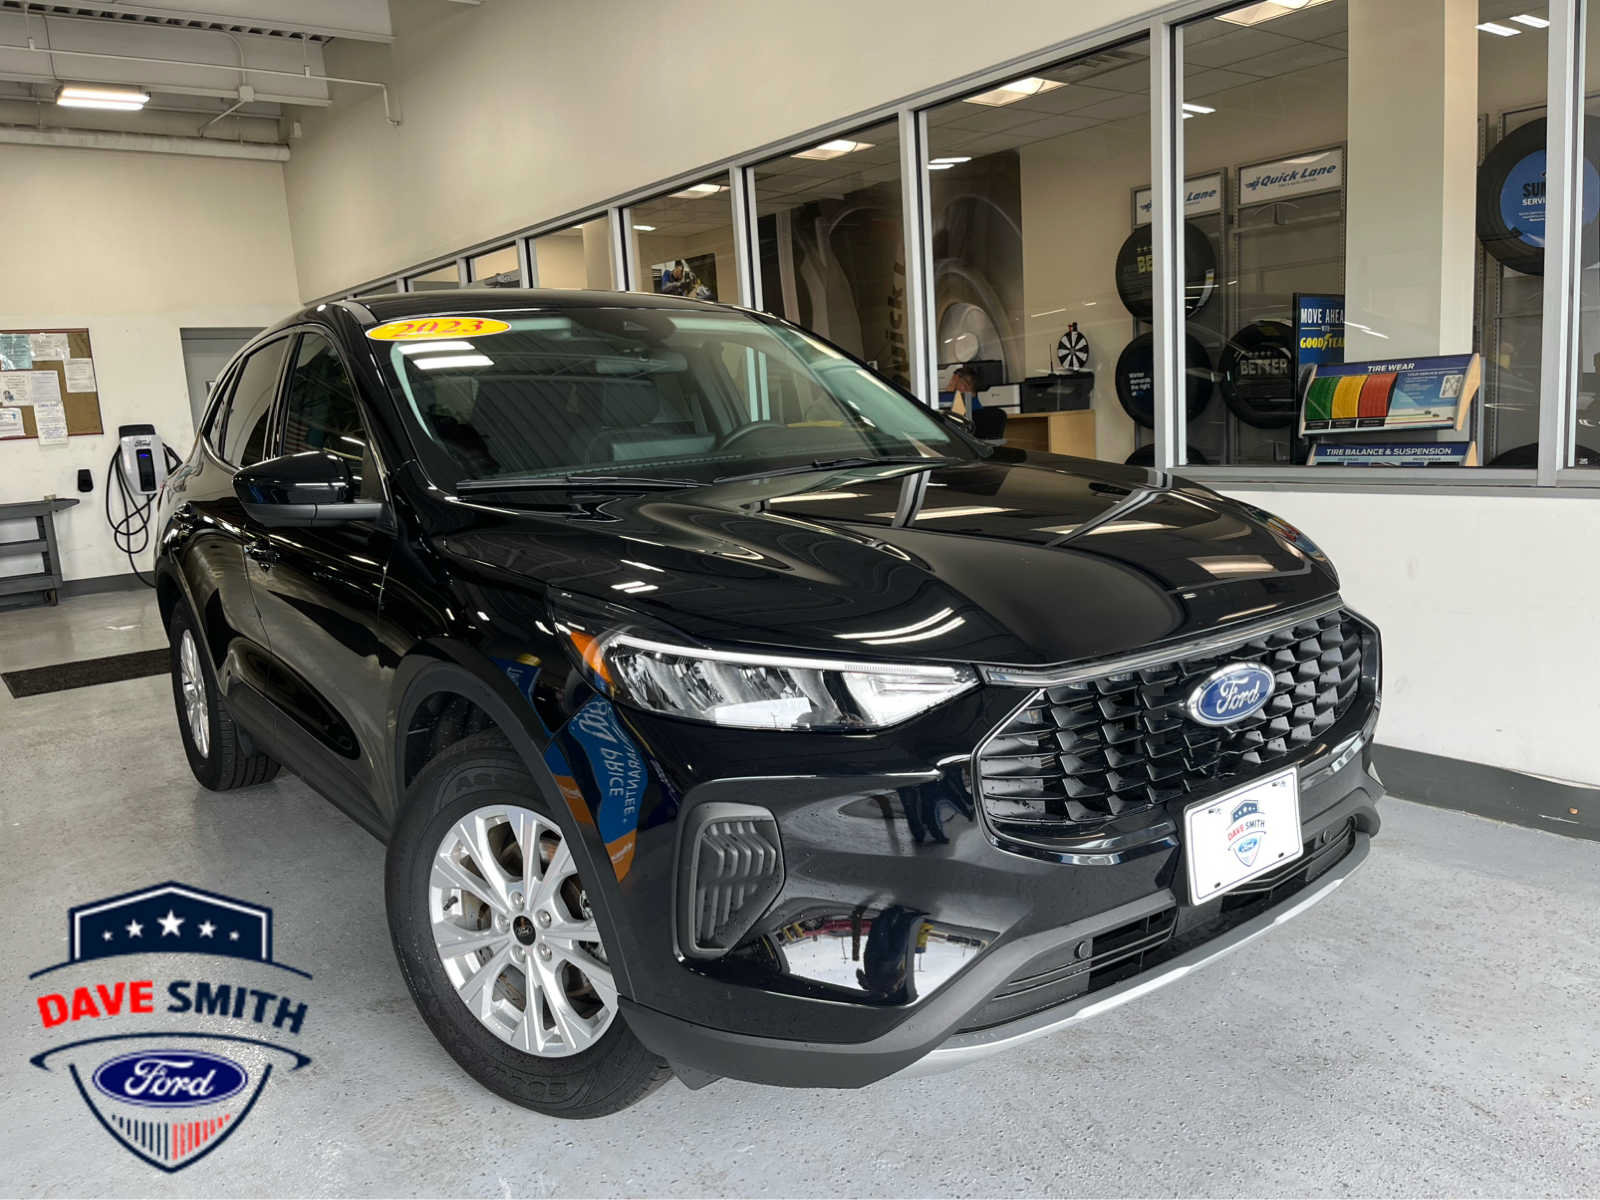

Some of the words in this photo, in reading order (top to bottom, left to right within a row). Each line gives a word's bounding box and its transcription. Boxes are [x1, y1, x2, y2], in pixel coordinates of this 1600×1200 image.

[1260, 170, 1299, 187] Quick
[1300, 164, 1337, 179] Lane
[1186, 188, 1217, 201] Lane
[1522, 197, 1546, 206] SERVI
[1300, 307, 1323, 324] MOVE
[1325, 308, 1345, 324] AHEA
[391, 319, 485, 338] 2023
[1239, 358, 1289, 376] BETTER
[1367, 364, 1387, 373] TIRE
[1388, 363, 1416, 372] WEAR
[1326, 448, 1344, 456] TIRE
[1345, 448, 1385, 456] BALANCE
[1393, 447, 1452, 455] SUSPENSION
[1216, 677, 1260, 714] Ford
[1227, 823, 1245, 841] DAVE
[1245, 819, 1265, 830] SMITH
